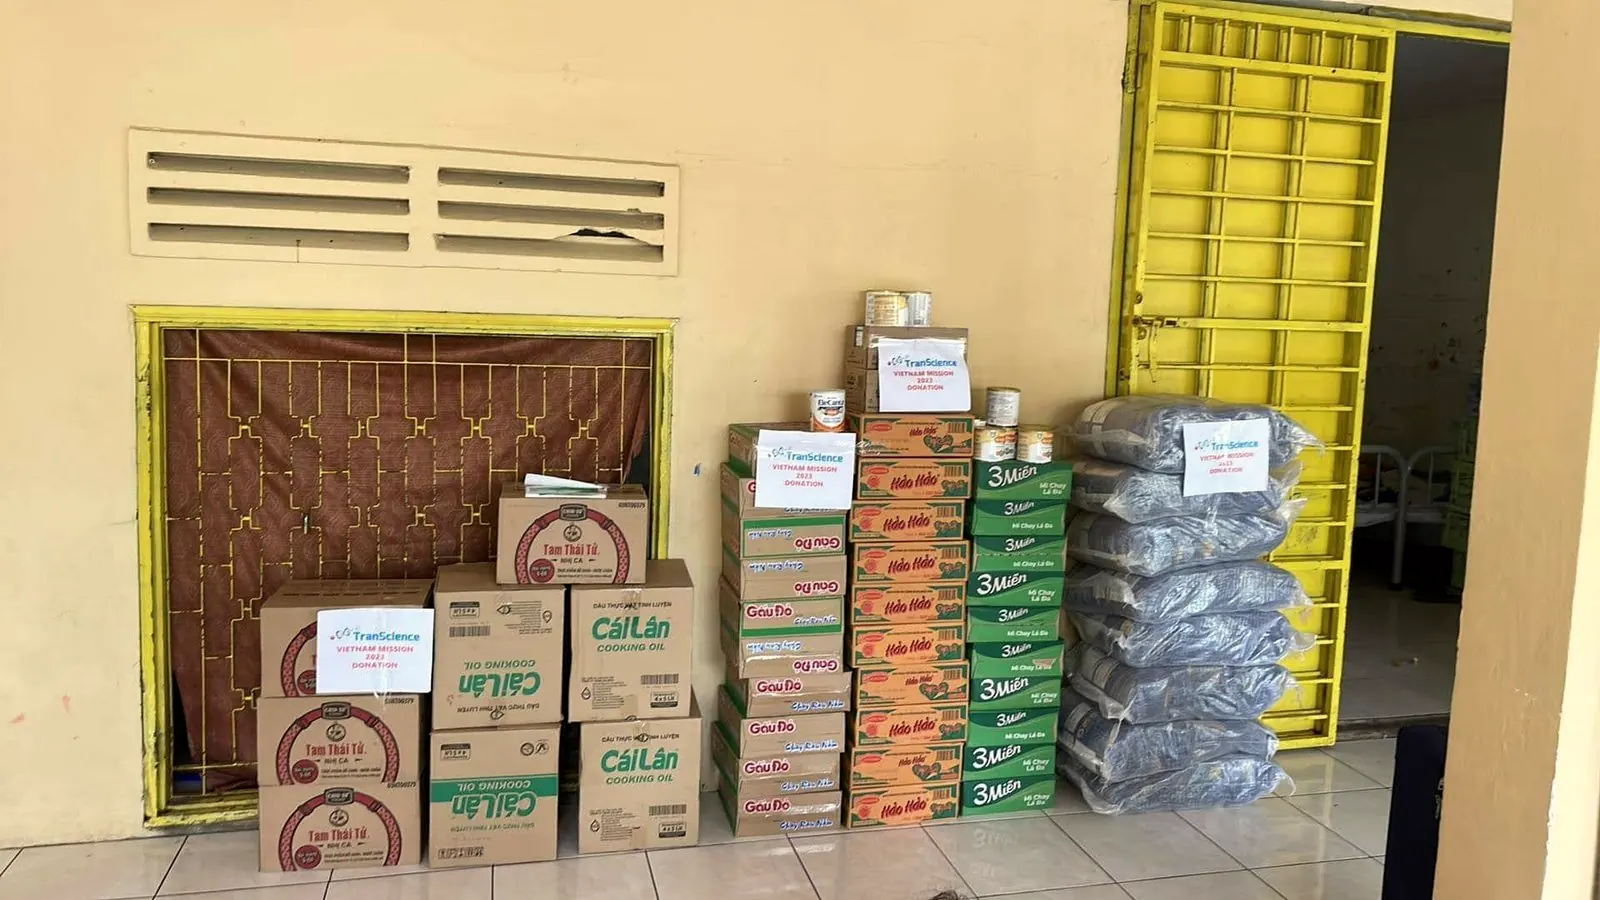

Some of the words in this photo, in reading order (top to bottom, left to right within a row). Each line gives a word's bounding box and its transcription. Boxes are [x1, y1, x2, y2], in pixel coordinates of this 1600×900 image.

[905, 358, 957, 367] TranScience
[1212, 441, 1258, 450] TraScience
[786, 452, 844, 462] TranScience
[773, 464, 805, 472] VIETNAM
[890, 474, 912, 490] Hảo
[915, 471, 938, 487] Hảo
[883, 516, 906, 532] Hảo
[908, 512, 930, 528] Hảo
[544, 544, 562, 555] Tam
[565, 543, 584, 555] Thái
[888, 558, 910, 574] Hảo
[912, 554, 935, 570] Hảo
[885, 599, 907, 615] Hảo
[909, 596, 931, 612] Hảo
[354, 631, 420, 642] TranScience
[597, 644, 646, 652] COOKING
[885, 641, 908, 657] Hảo
[910, 637, 932, 653] Hảo
[464, 662, 482, 670] OIL
[485, 660, 536, 670] COOKING
[889, 721, 912, 737] Hảo
[913, 717, 936, 732] Hảo
[306, 744, 326, 756] Tam
[329, 744, 350, 756] Thái
[606, 775, 654, 784] COOKING
[657, 774, 673, 782] OIL
[457, 783, 474, 792] OIL
[479, 780, 531, 790] COOKING
[881, 802, 902, 818] Hảo
[904, 797, 926, 813] Hảo
[308, 830, 328, 842] Tam
[332, 830, 352, 840] Thái
